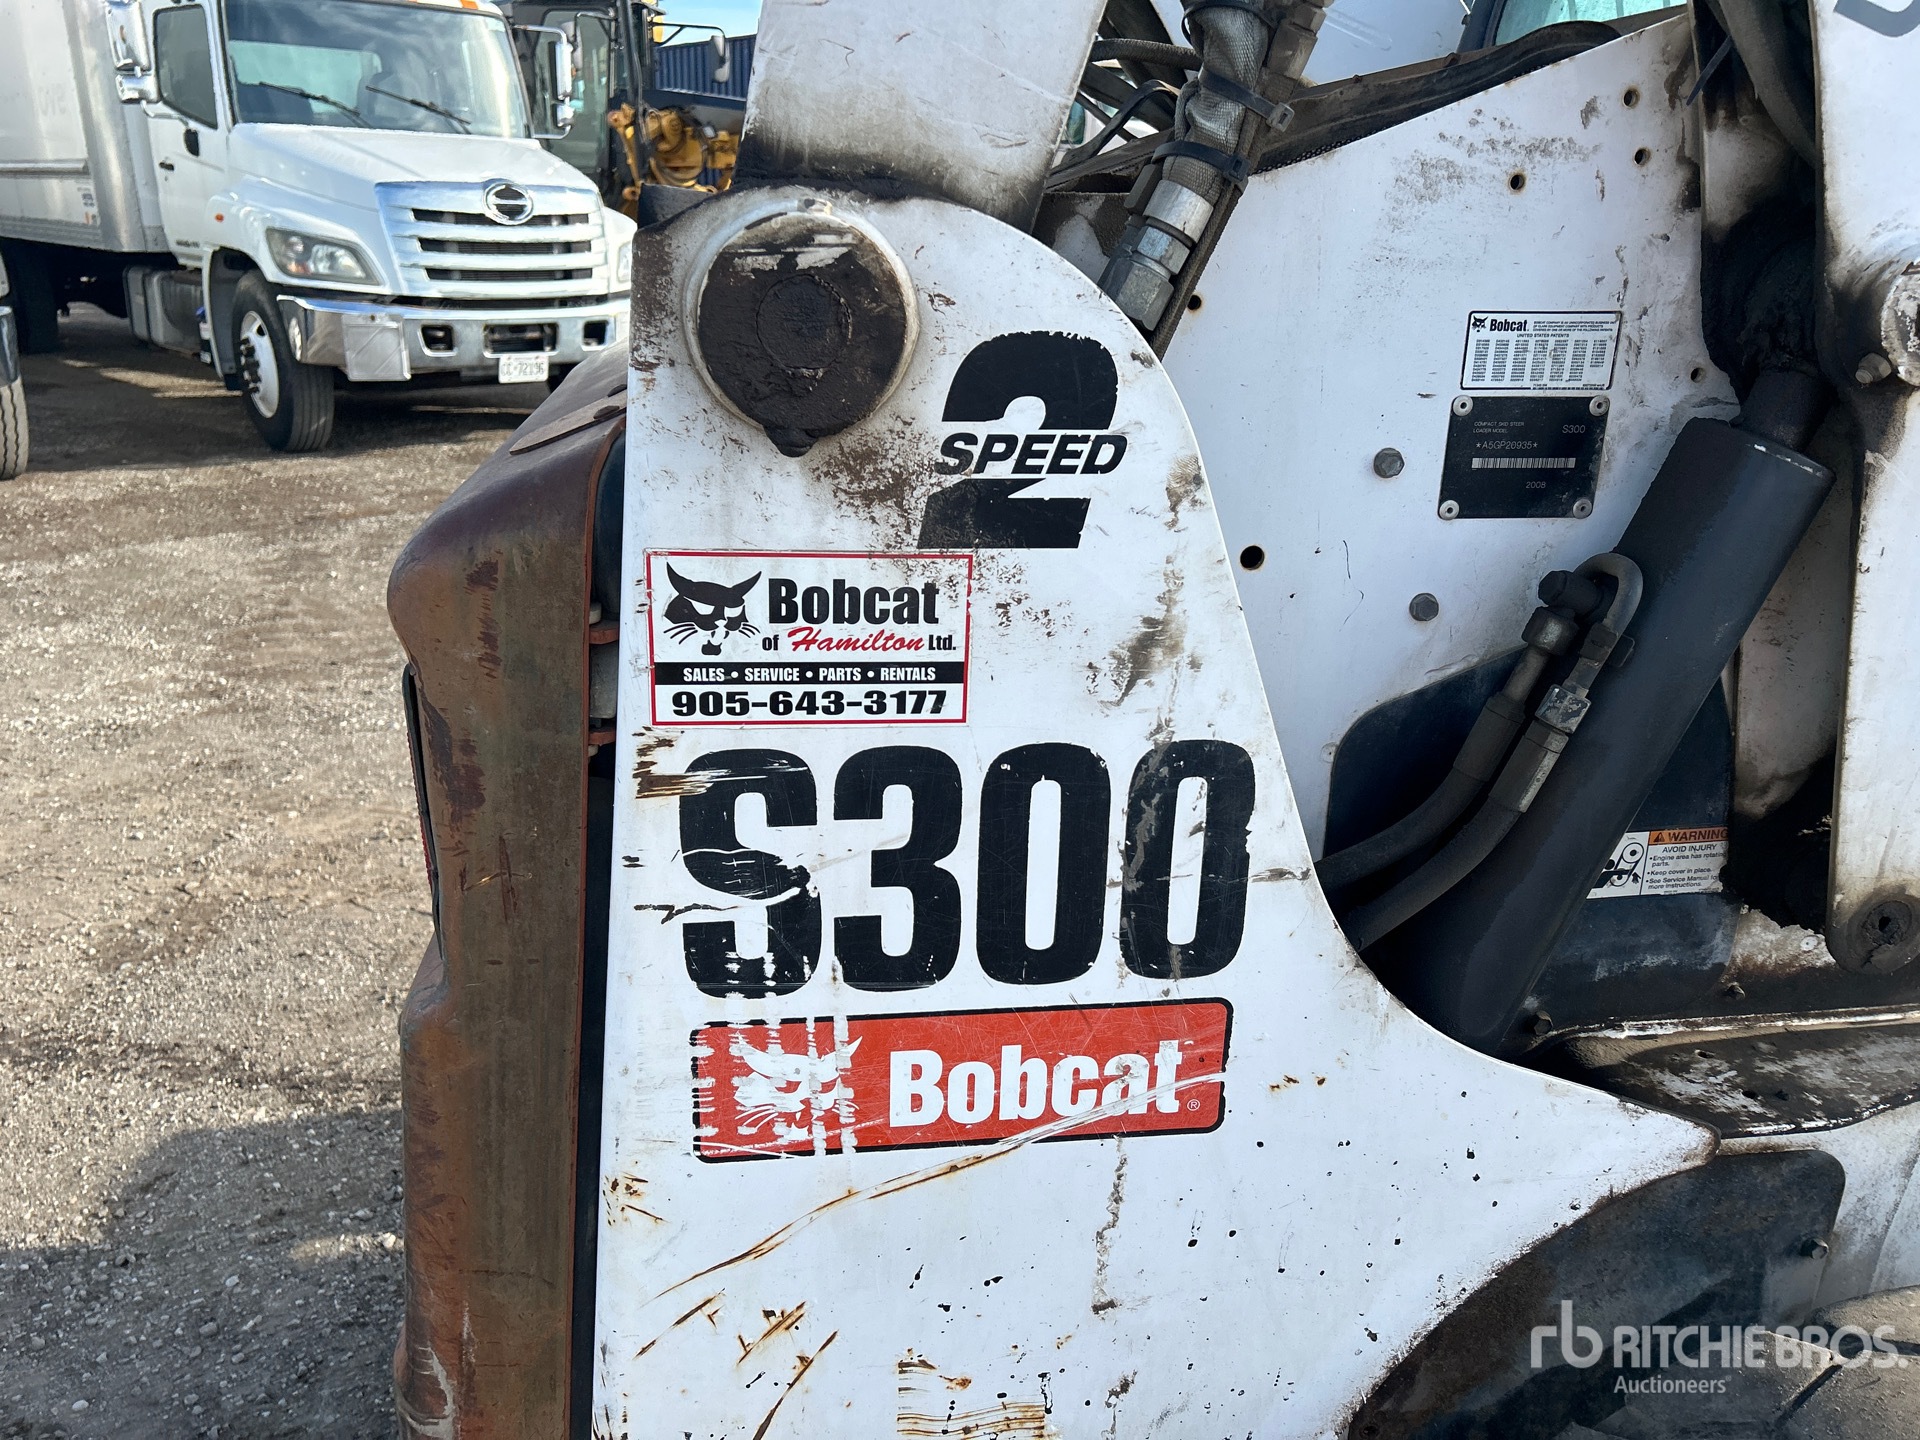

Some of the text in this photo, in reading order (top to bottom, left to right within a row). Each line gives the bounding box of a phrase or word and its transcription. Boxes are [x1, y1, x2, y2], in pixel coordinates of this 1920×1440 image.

[1489, 319, 1528, 332] Bobcat
[916, 330, 1118, 548] 2
[1562, 424, 1586, 434] S300
[934, 432, 1128, 475] SPEED
[1525, 481, 1547, 489] 2008
[767, 577, 940, 625] Bobcat
[761, 626, 957, 652] of Hamilton Ltd.
[683, 666, 936, 682] SALES SERVICE PARTS RENTALS
[671, 689, 947, 717] 905-643-3177
[1668, 829, 1728, 842] WARNING
[679, 739, 1256, 999] S300
[889, 1039, 1183, 1128] Bobcat
